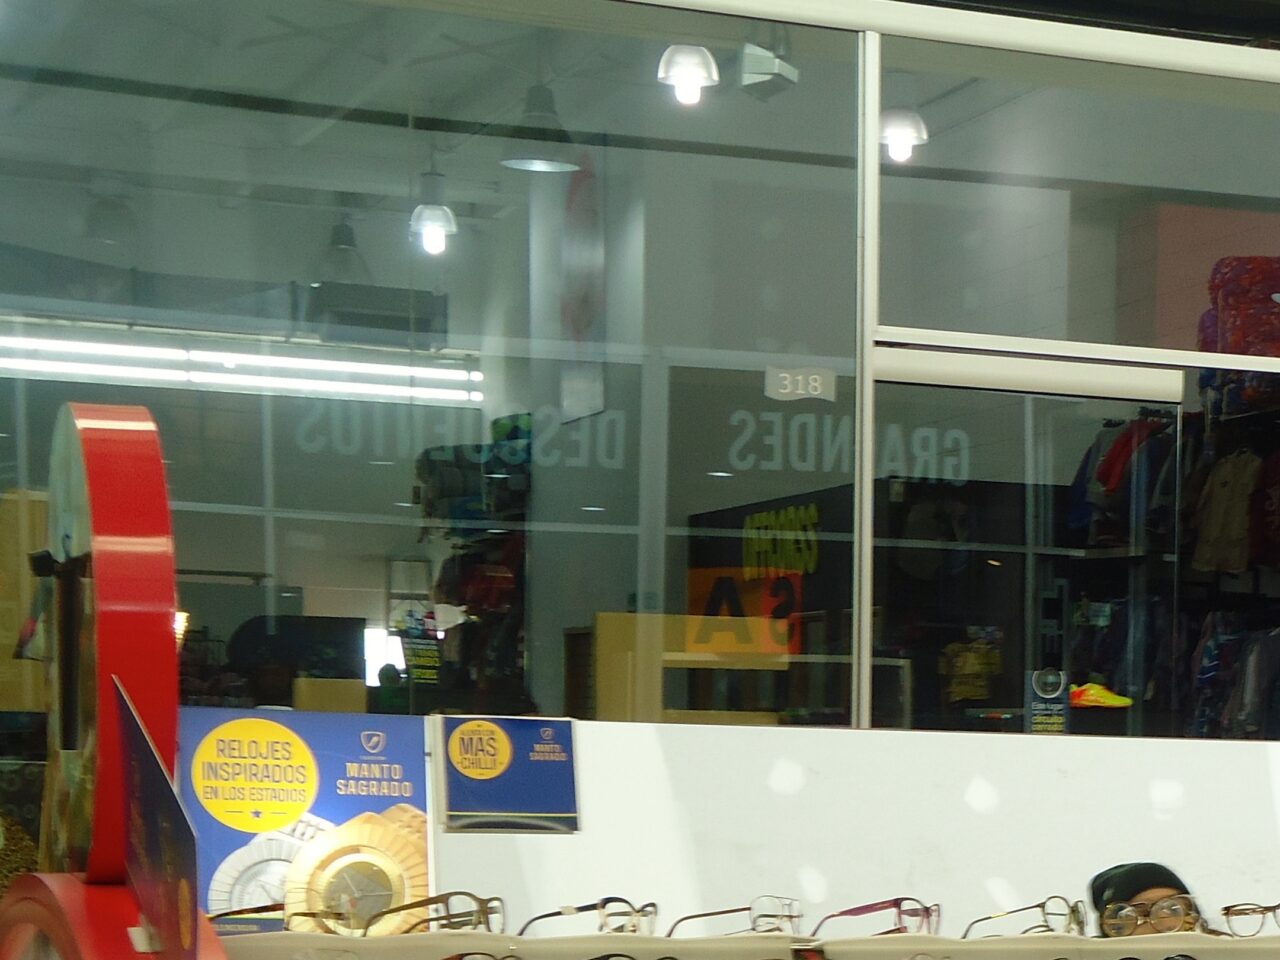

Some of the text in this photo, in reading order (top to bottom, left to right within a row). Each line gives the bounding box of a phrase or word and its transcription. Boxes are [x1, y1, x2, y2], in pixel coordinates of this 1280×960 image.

[778, 373, 822, 394] 318
[216, 738, 293, 761] RELOJES
[202, 761, 308, 784] INSPIRADOS
[345, 762, 404, 780] MANTO
[203, 785, 307, 803] EN LOS ESTADIOS
[335, 779, 414, 797] SAGRADO
